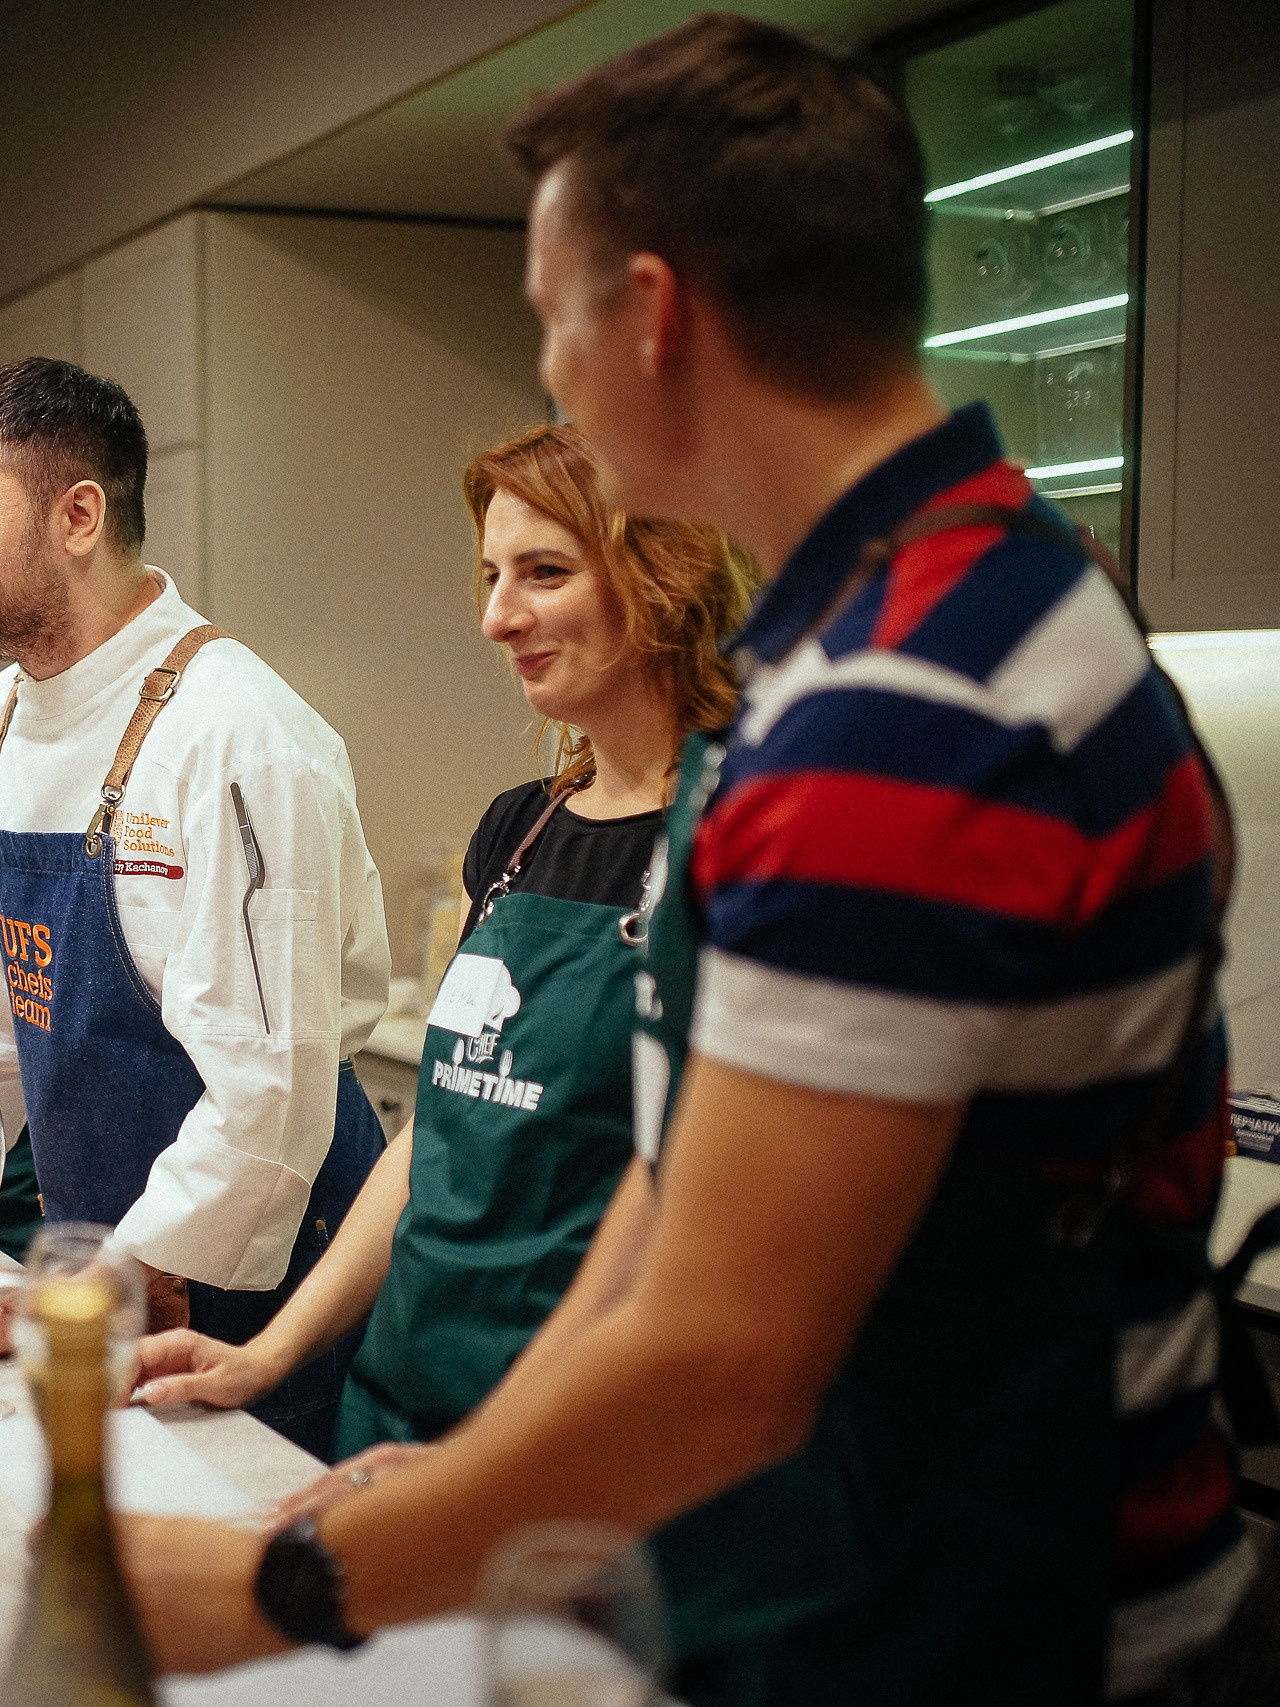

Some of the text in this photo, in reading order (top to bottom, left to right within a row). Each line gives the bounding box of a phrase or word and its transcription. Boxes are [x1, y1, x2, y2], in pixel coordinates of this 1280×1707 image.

[123, 825, 153, 839] Food
[126, 812, 170, 829] Unilever
[123, 839, 175, 857] Solutions
[0, 914, 52, 967] UFS
[7, 961, 53, 1001] chefs
[10, 986, 51, 1032] team
[431, 1055, 544, 1111] PRIMETIME
